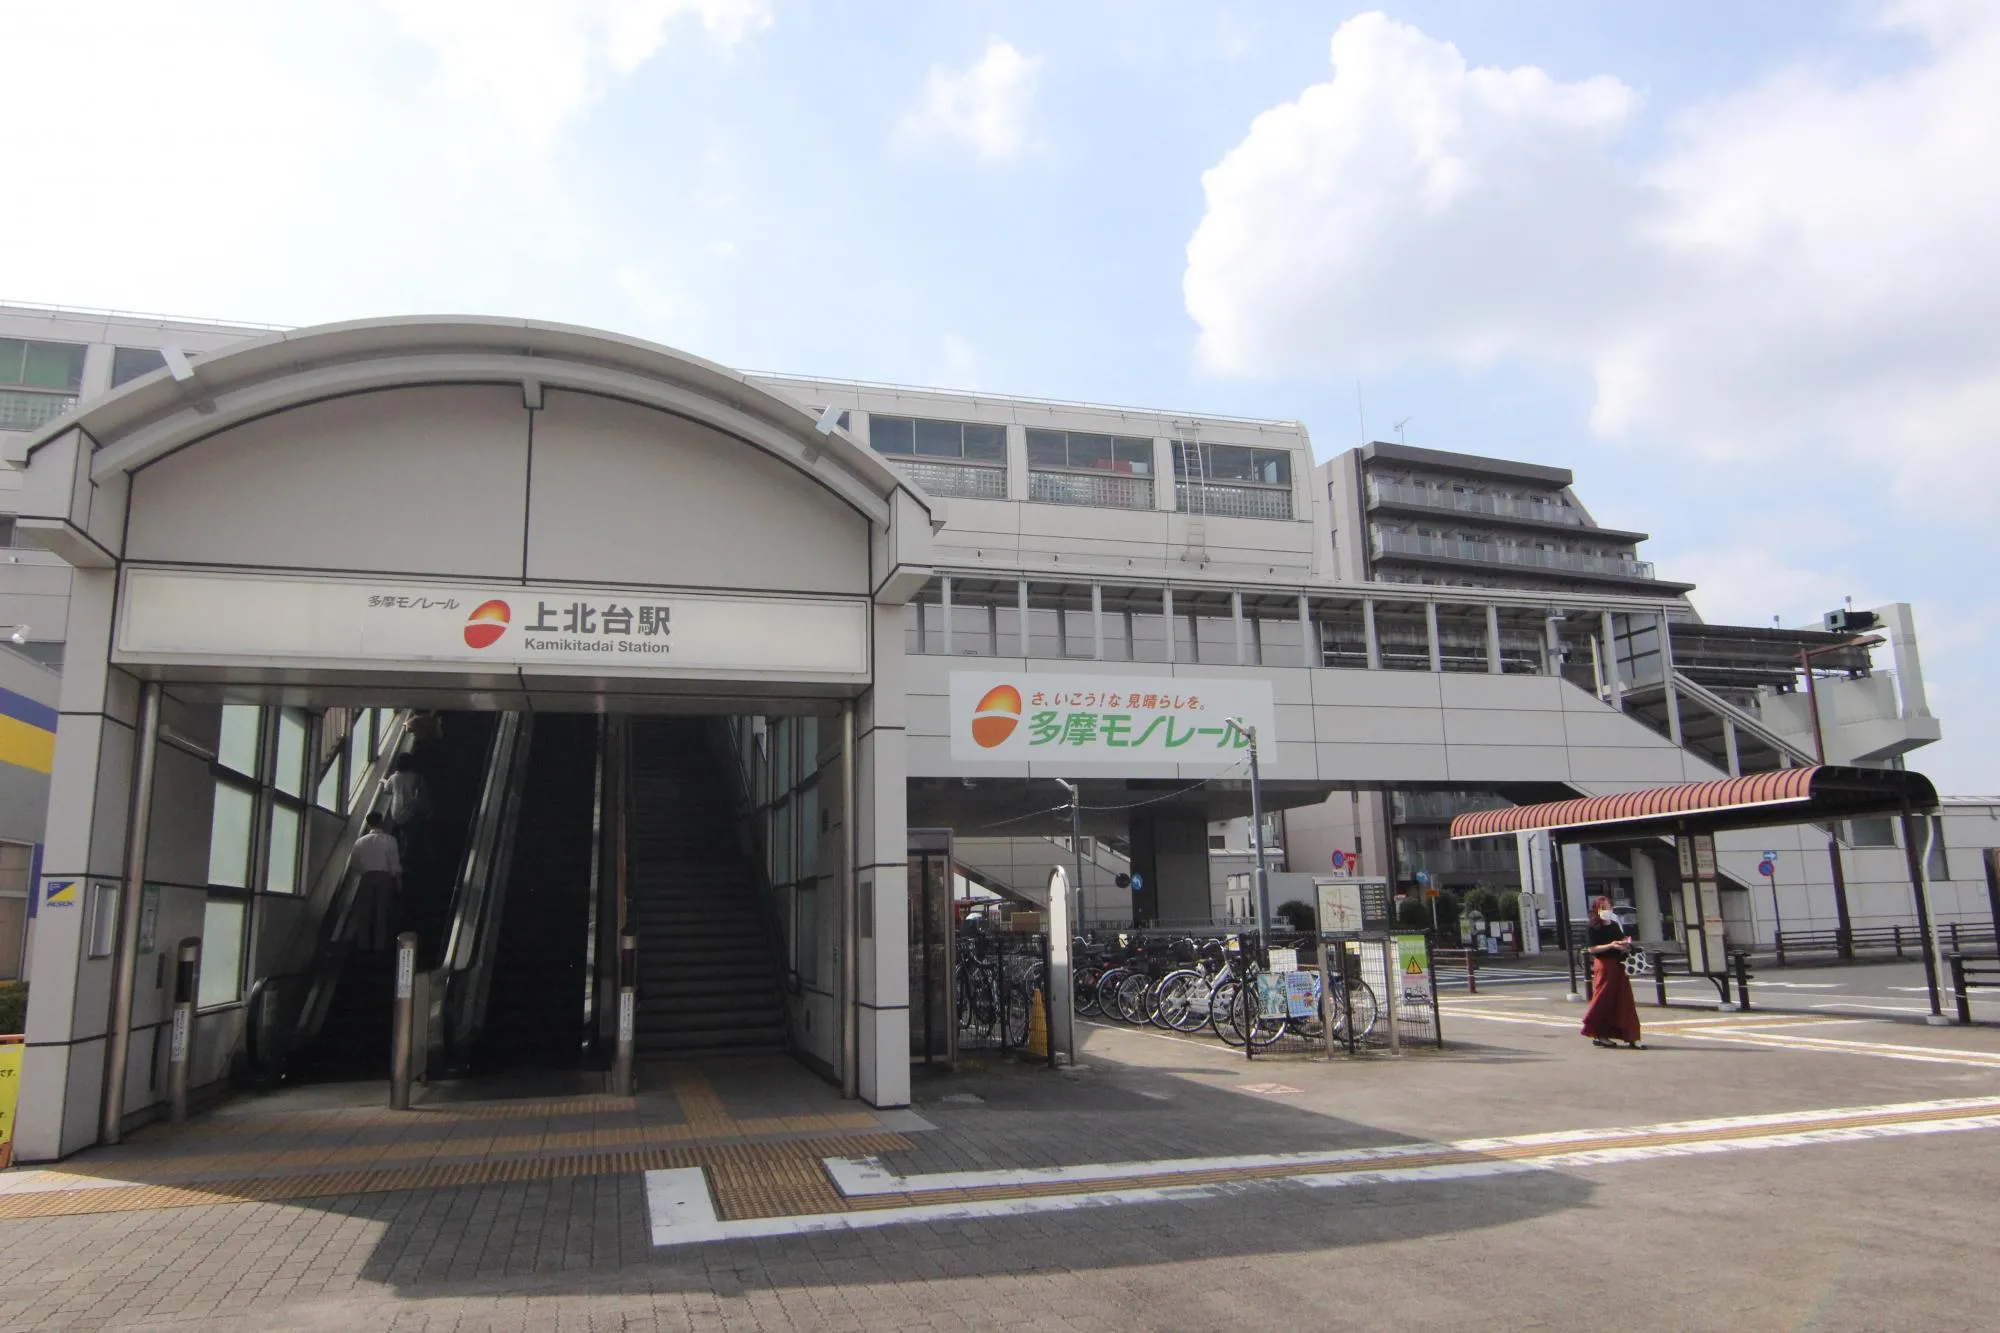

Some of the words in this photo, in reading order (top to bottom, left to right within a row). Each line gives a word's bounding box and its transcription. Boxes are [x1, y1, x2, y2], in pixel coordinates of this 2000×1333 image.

[368, 595, 460, 610] 多摩モノレール
[524, 601, 671, 636] 上北台駅
[524, 638, 615, 653] Kamikitadai
[618, 640, 670, 654] Station
[1028, 711, 1250, 748] 多摩モノレール
